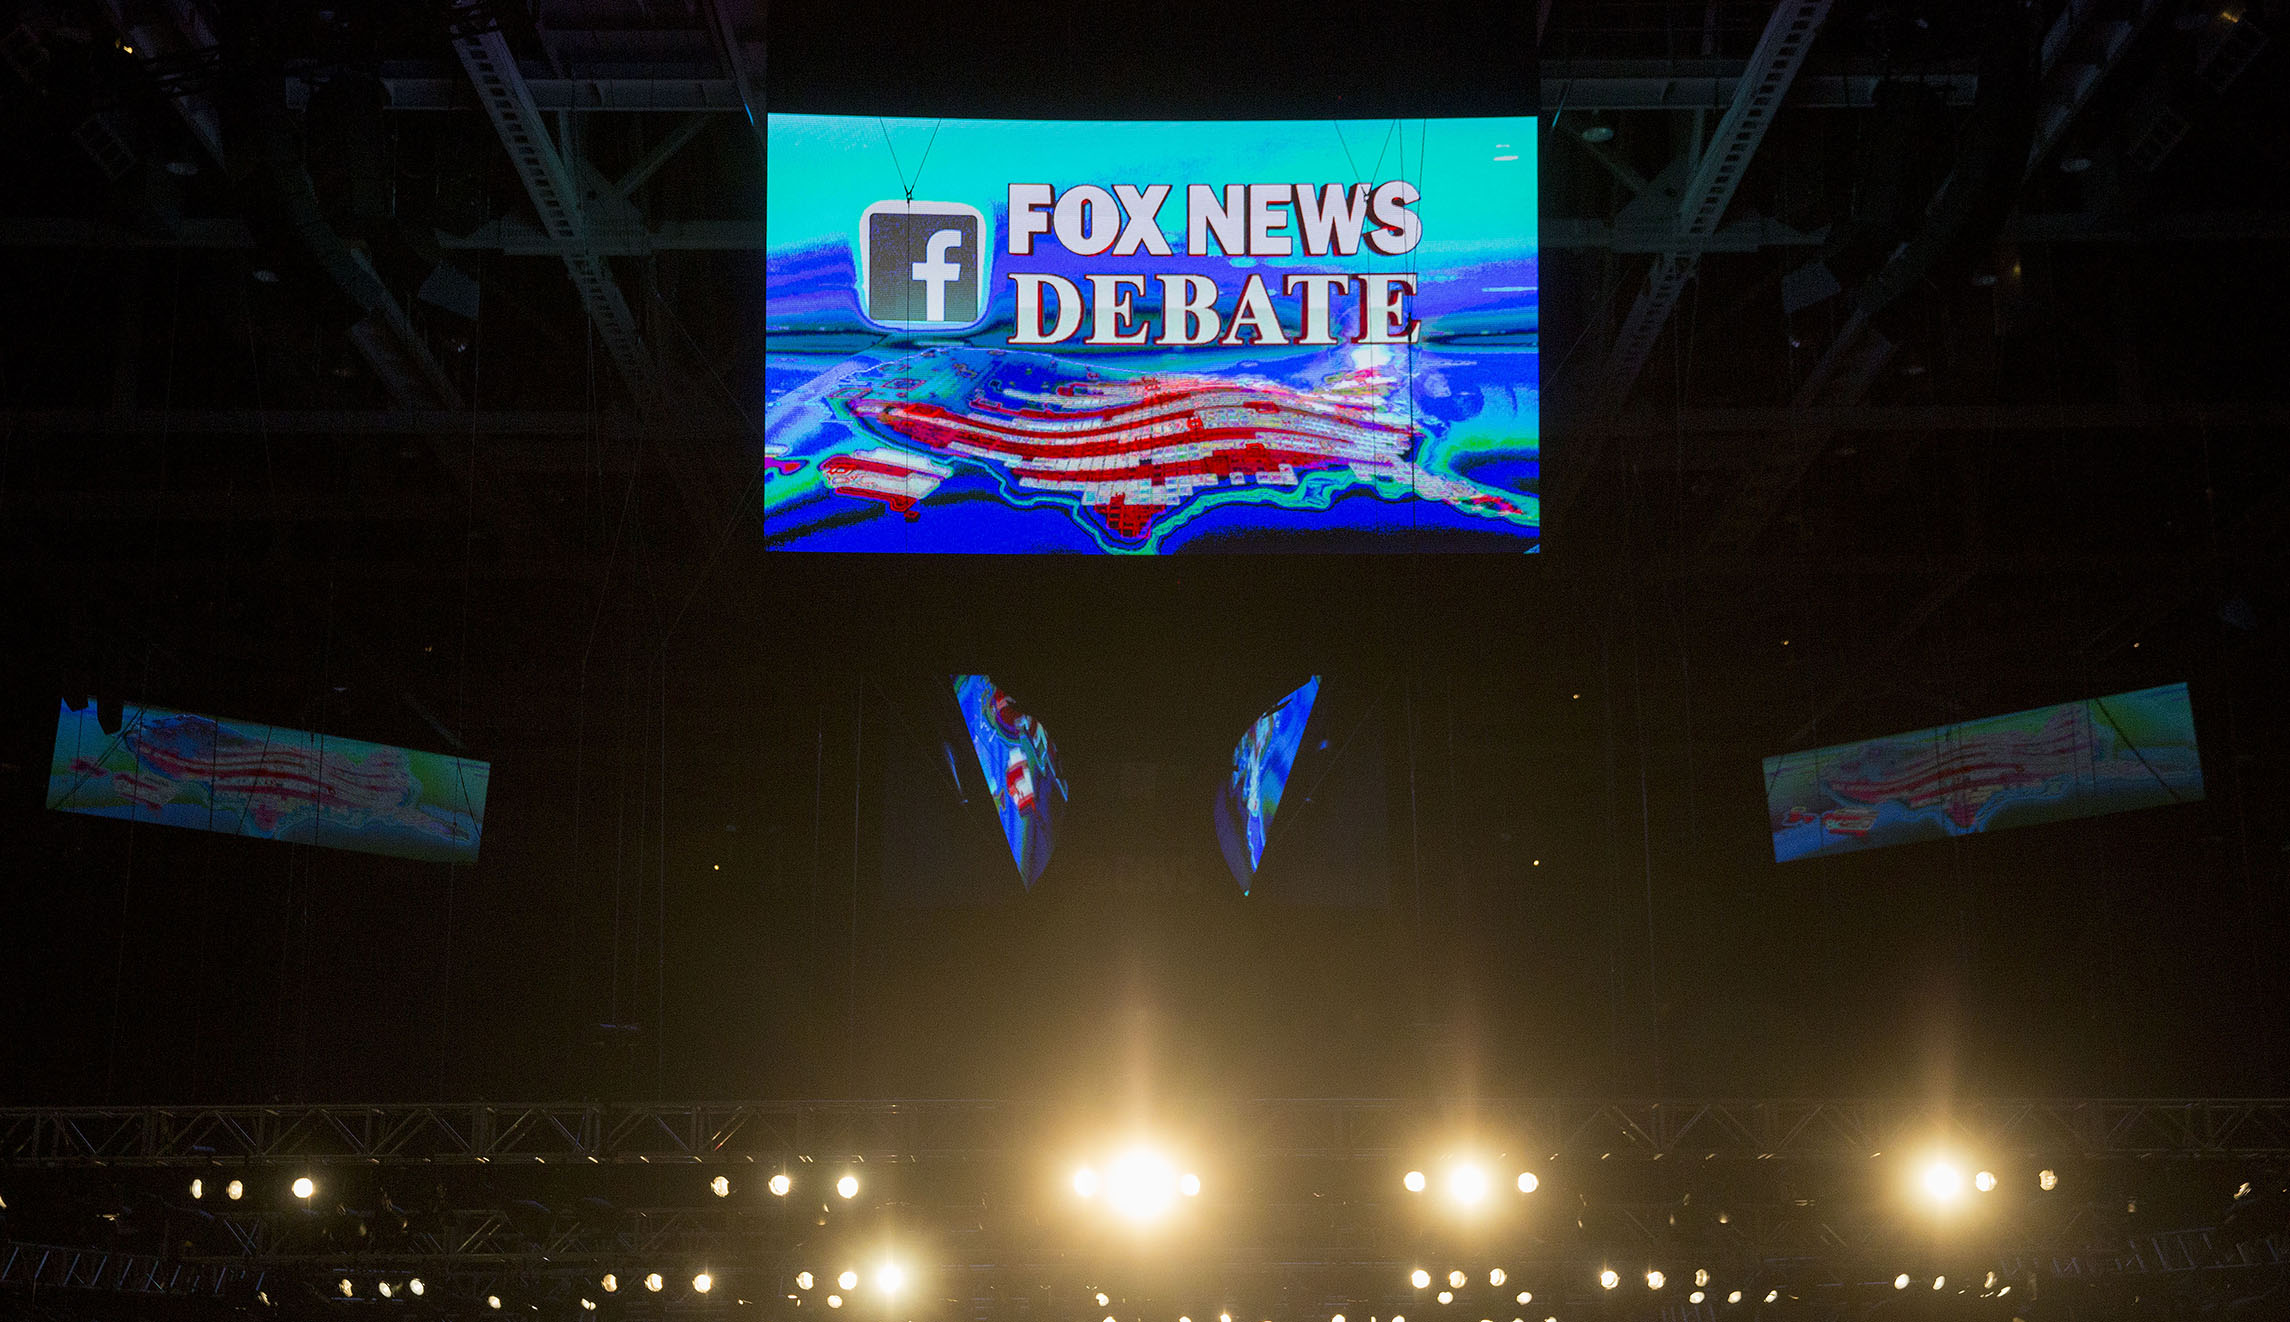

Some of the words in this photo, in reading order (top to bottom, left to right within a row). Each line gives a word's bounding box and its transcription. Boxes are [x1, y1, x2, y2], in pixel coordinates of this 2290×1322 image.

[1007, 183, 1173, 256] FOX
[1187, 180, 1423, 256] NEWS
[911, 228, 962, 321] f
[1007, 273, 1421, 345] DEBATE
